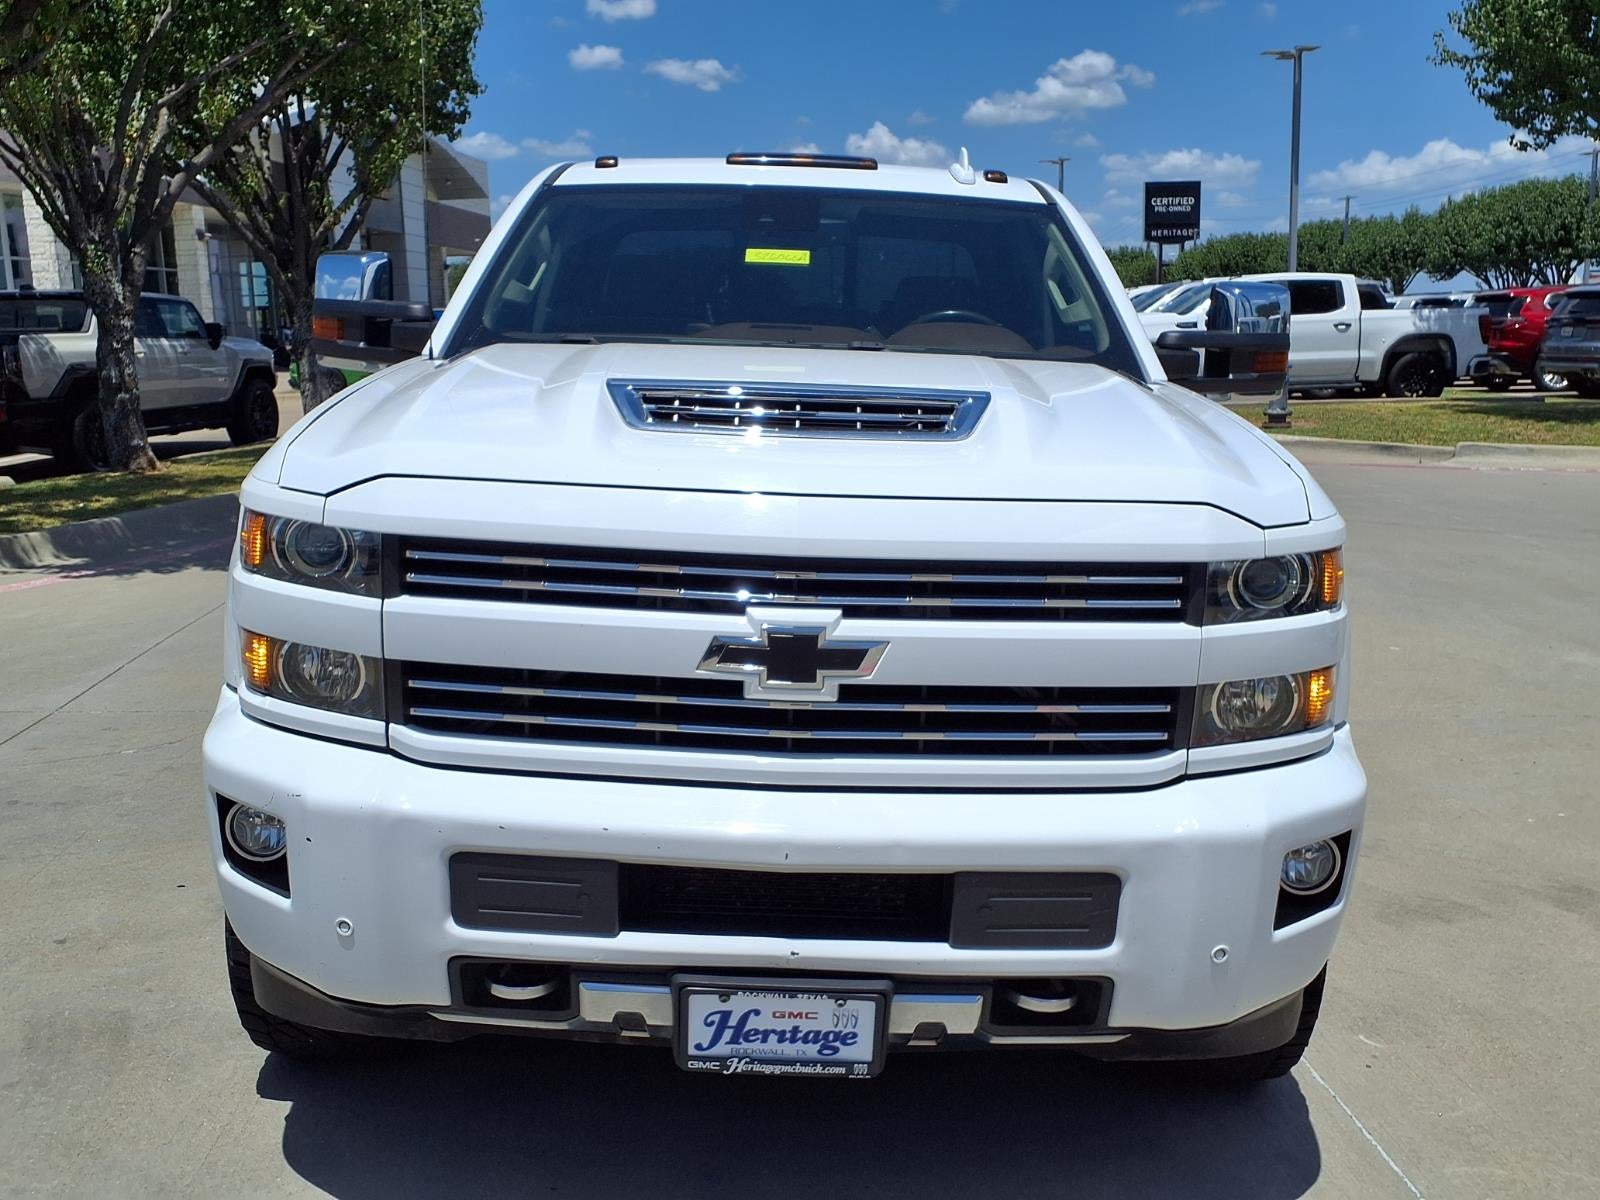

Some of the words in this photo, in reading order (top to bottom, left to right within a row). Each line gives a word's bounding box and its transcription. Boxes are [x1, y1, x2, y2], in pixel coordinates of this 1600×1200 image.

[1151, 197, 1195, 205] CERTIFIED
[1151, 229, 1194, 237] HERITAGE
[771, 1010, 819, 1020] GMC
[693, 1008, 858, 1056] Heritage
[687, 1060, 721, 1070] GMC
[722, 1057, 846, 1074] Heritagegmcbuick.com
